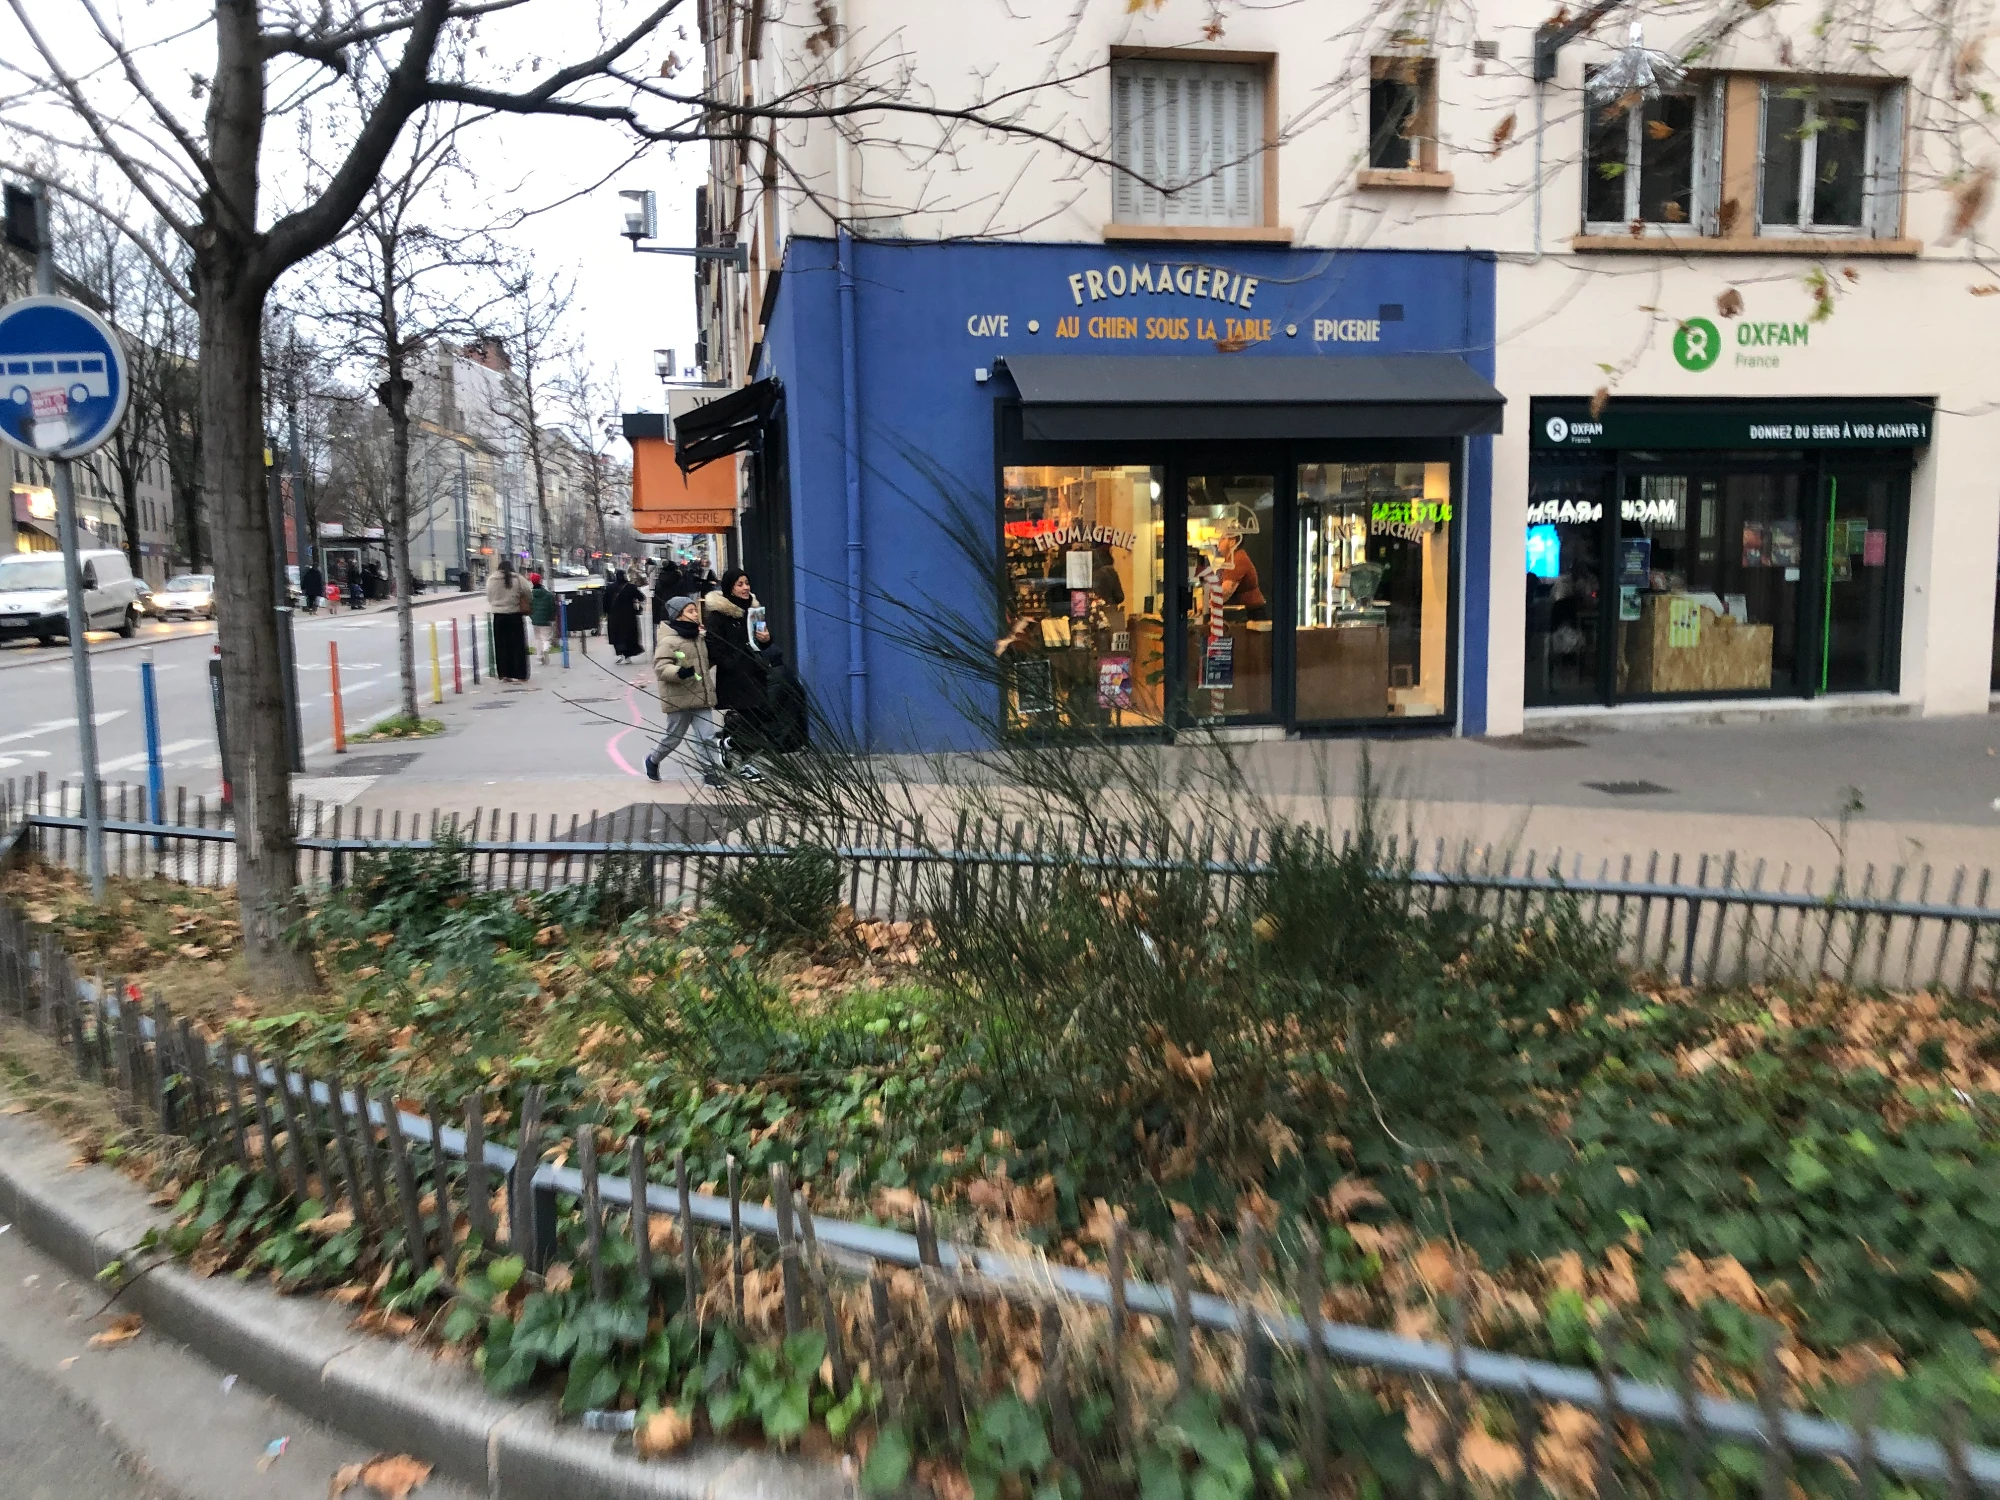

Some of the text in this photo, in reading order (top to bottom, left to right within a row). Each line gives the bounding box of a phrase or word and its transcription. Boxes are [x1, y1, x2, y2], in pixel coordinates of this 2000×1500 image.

[1068, 263, 1259, 309] FROMAGERIE
[967, 315, 1008, 337] CAVE
[1055, 316, 1271, 341] AU CHIEN SOUS LA TABLE
[1314, 319, 1381, 342] EPICERIE
[1737, 322, 1809, 346] OXFAM
[1735, 352, 1780, 368] France
[1570, 422, 1603, 435] OXFAM
[1750, 424, 1792, 439] DONNEZ
[1794, 425, 1810, 439] DU
[1812, 424, 1840, 439] SENS
[1843, 420, 1851, 439] À
[1852, 424, 1875, 439] VOS
[1876, 423, 1919, 438] ACHATS
[659, 512, 720, 524] PATISSERIE
[1033, 524, 1138, 552] FROMAGERIE
[1371, 519, 1424, 545] EPICERIE
